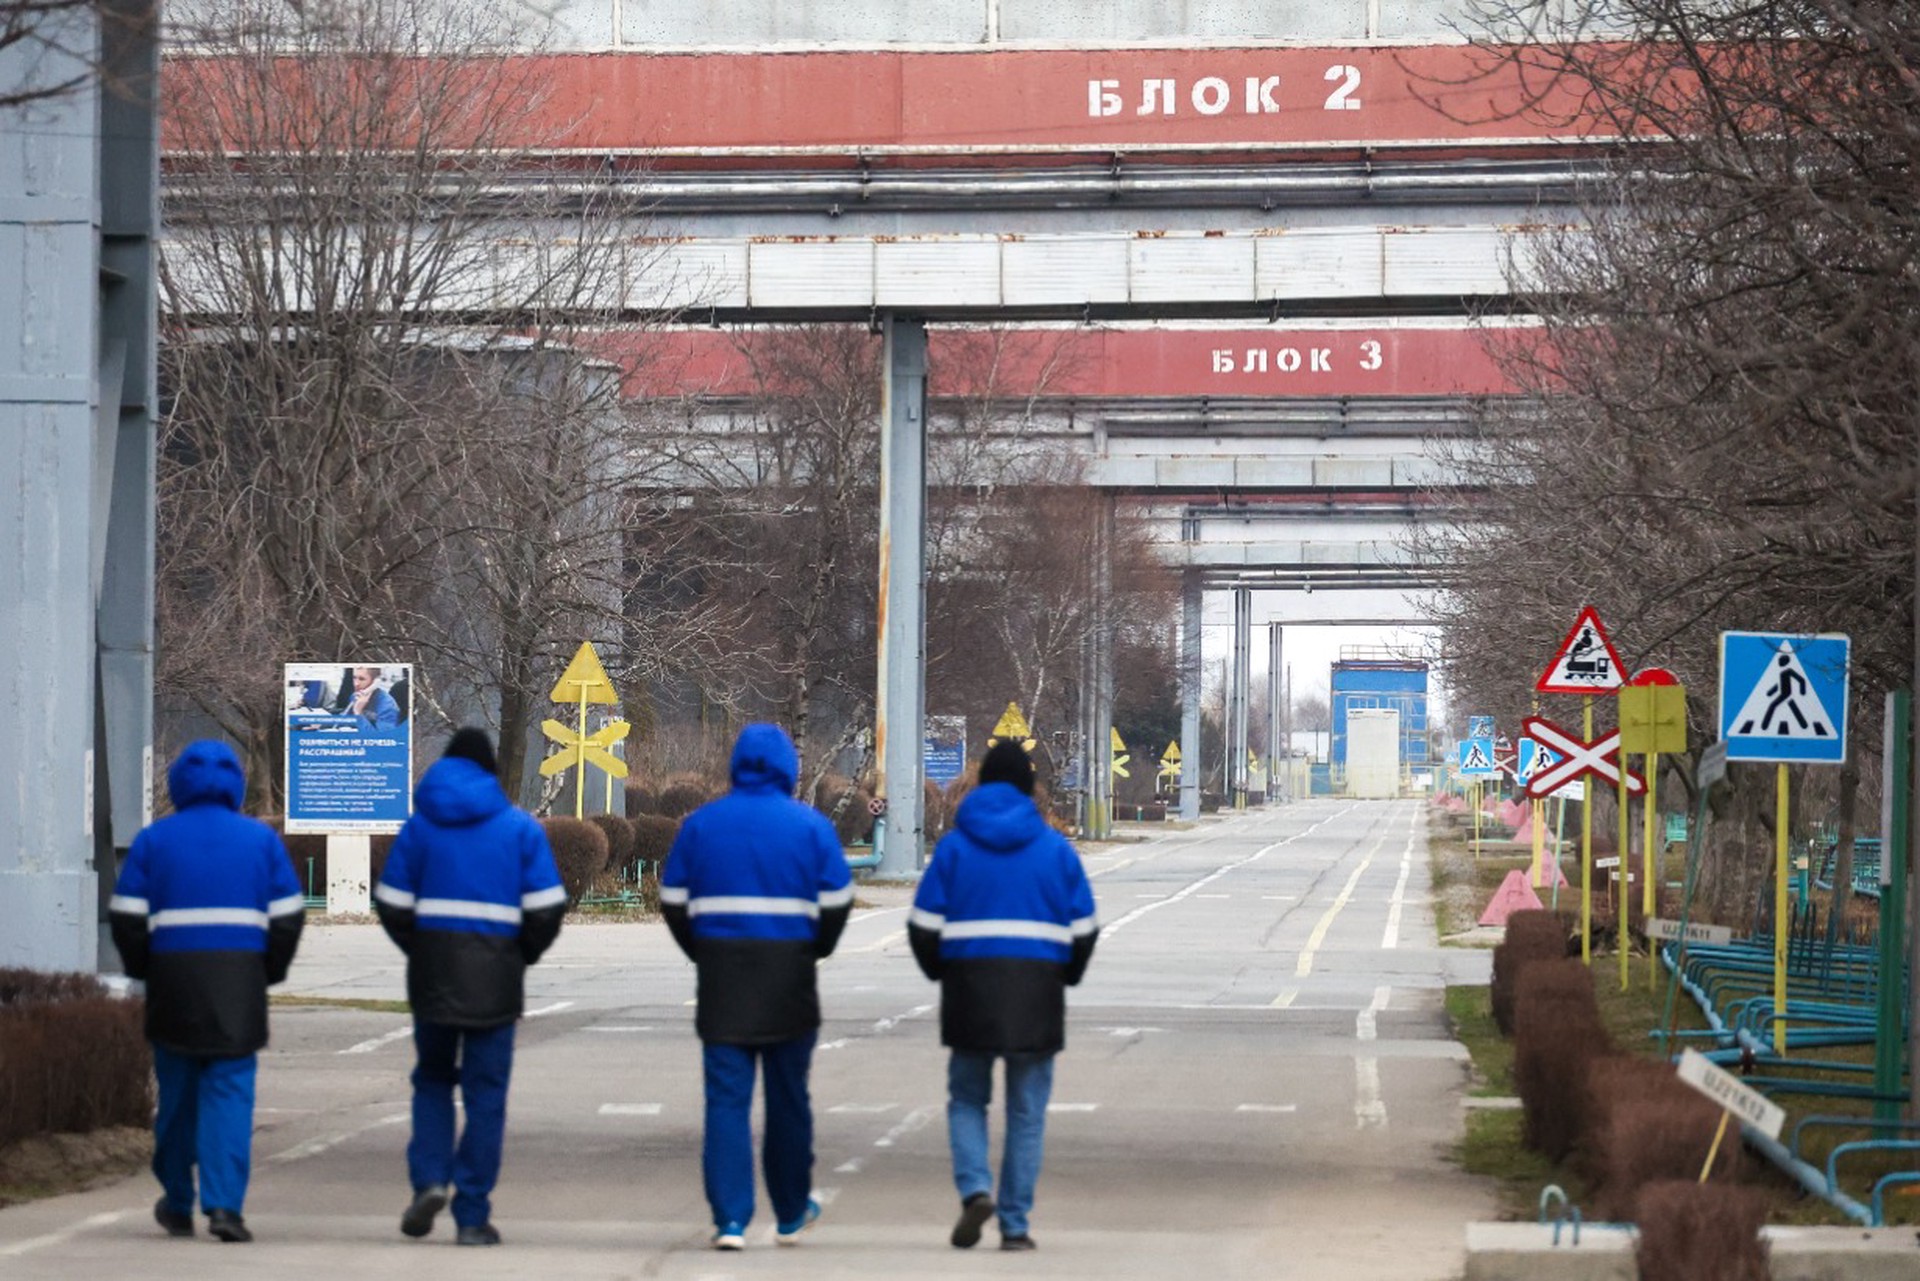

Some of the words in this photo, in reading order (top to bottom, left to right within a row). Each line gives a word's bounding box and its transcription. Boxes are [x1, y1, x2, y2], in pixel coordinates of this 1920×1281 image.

[1088, 76, 1280, 117] БЛОК
[1323, 65, 1361, 110] 2
[1212, 348, 1332, 373] БЛОК
[1359, 339, 1383, 371] 3
[351, 739, 362, 747] НЕ
